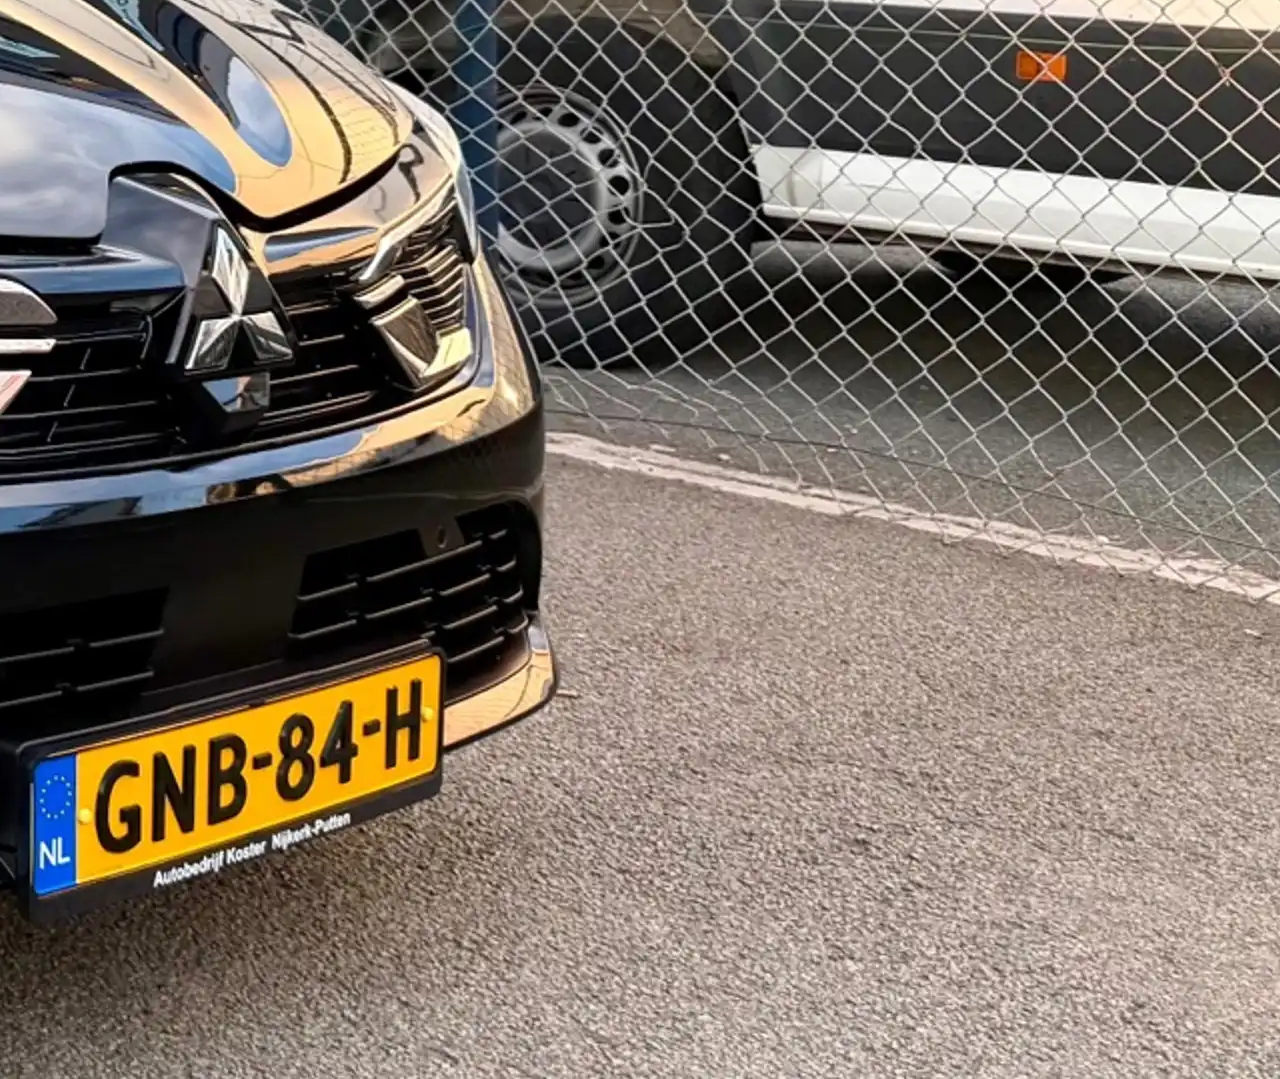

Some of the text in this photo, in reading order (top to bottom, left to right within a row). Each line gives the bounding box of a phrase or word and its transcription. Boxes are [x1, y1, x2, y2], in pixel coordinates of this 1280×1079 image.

[95, 679, 422, 853] GNB-84-H
[39, 838, 71, 870] NL
[153, 812, 351, 888] Autobedrijf Koster Nijkerk-Putten
